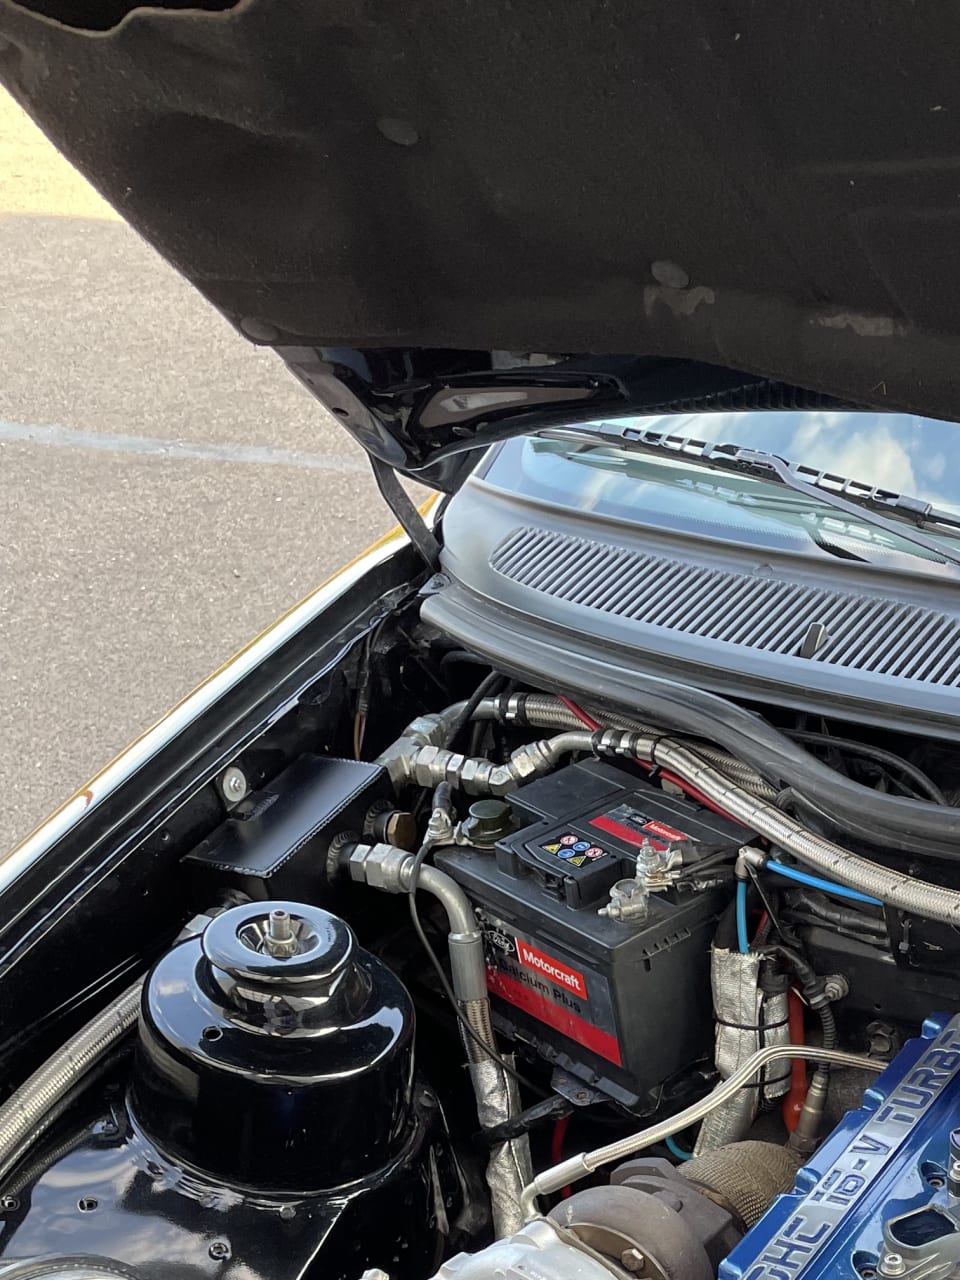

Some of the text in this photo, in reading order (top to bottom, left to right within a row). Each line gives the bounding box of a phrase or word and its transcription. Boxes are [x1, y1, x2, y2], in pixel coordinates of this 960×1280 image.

[500, 958, 581, 1014] Calcium Plus
[522, 948, 581, 991] Motorcraft
